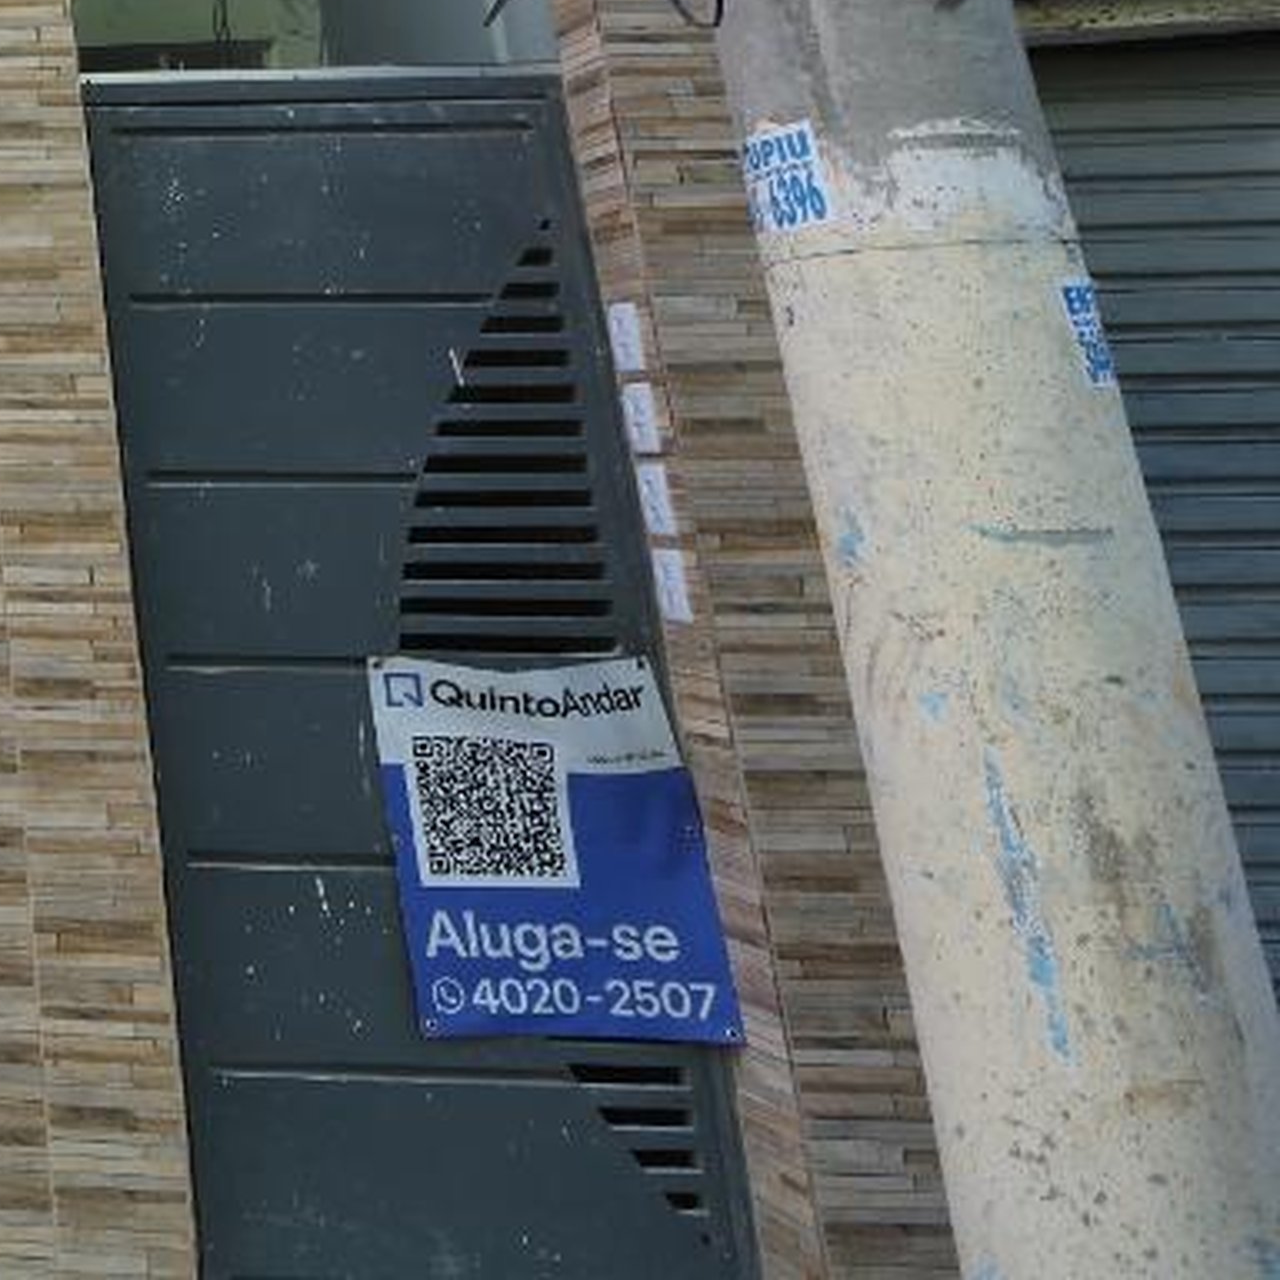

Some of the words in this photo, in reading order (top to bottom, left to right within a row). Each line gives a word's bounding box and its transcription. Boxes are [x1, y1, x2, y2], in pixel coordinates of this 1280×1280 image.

[430, 678, 644, 718] QuintoAndar
[426, 910, 682, 971] Aluga-se
[473, 977, 717, 1021] 4020-2507
